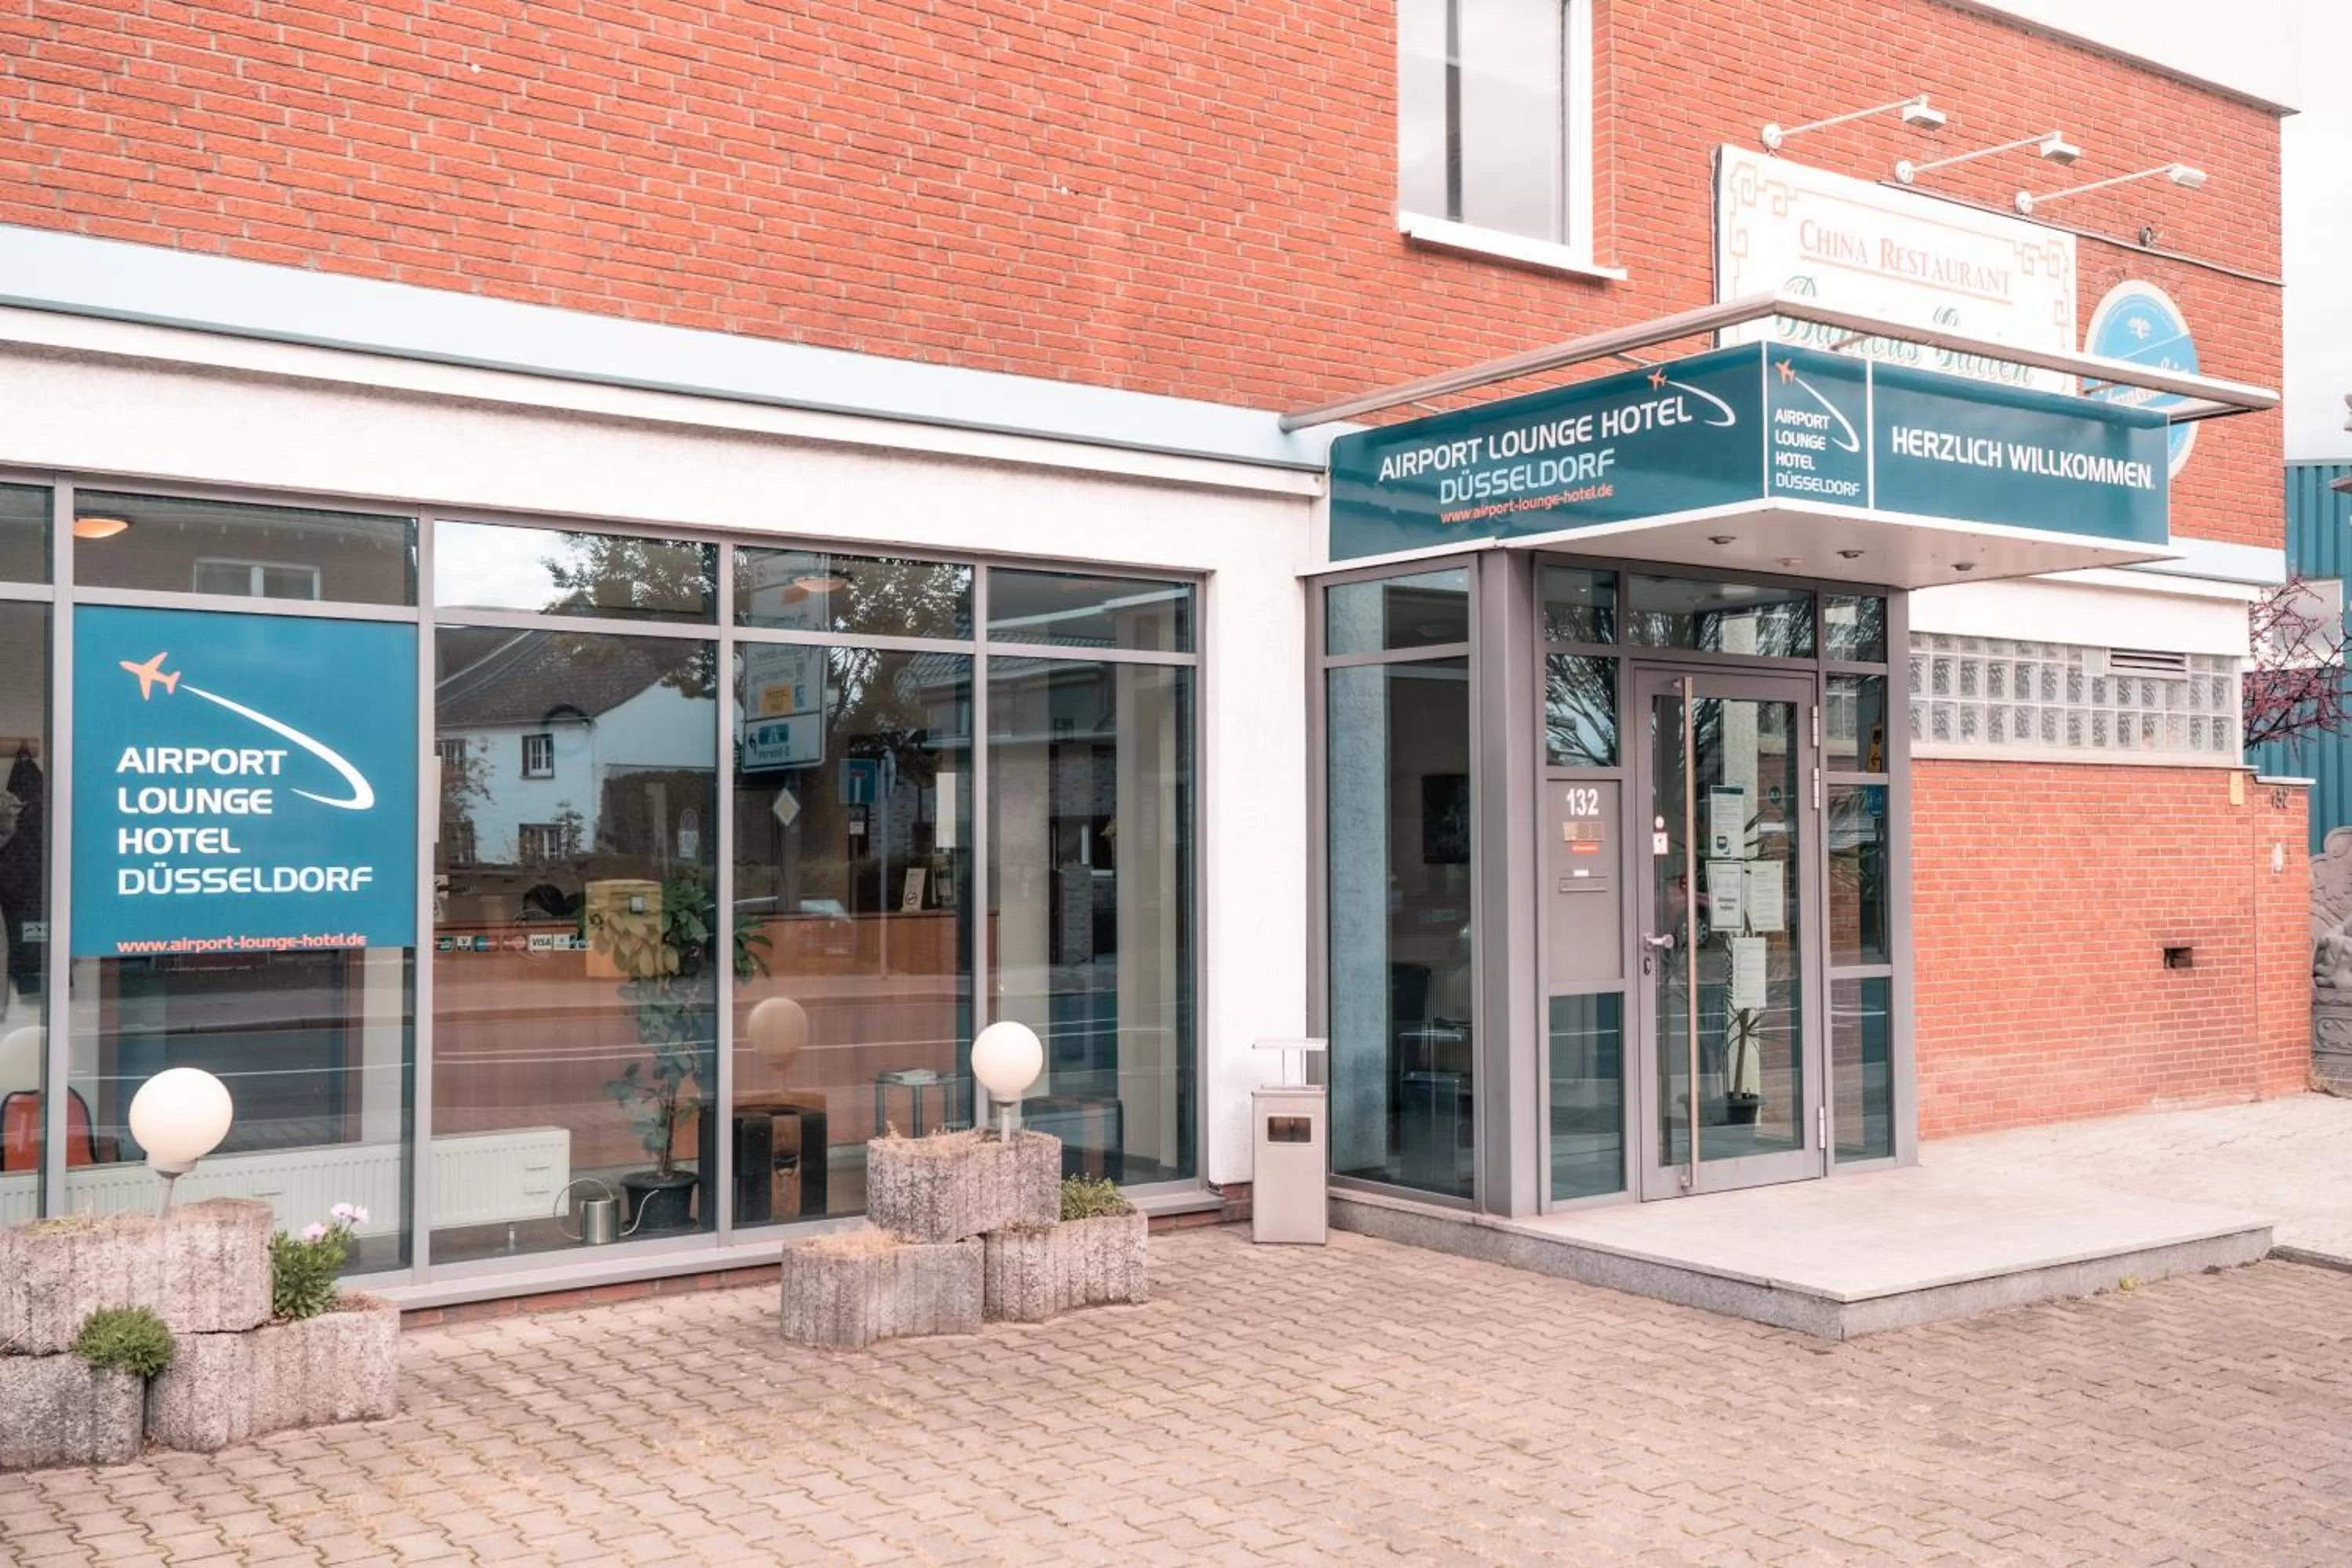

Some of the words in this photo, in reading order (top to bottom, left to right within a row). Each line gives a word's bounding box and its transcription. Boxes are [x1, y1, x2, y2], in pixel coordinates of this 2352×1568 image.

[1799, 220, 1868, 264] CHINA
[1880, 238, 2011, 296] RESTAURANT
[1774, 408, 1831, 430] AIRPORT
[1378, 437, 1483, 482] AIRPORT
[1489, 415, 1593, 459] LOUNGE
[1601, 395, 1693, 439] HOTEL
[1774, 429, 1827, 451] LOUNGE
[1891, 426, 2003, 468] HERZLICH
[1775, 451, 1817, 471] HOTEL
[1439, 448, 1616, 506] DÜSSELDORF
[1775, 470, 1861, 497] DÜSSELDORF
[1440, 482, 1613, 524] www.airport-lounge-hotel.de
[116, 747, 288, 775] AIRPORT
[118, 787, 273, 815] LOUNGE
[1566, 788, 1599, 816] 132
[118, 828, 241, 855] HOTEL
[118, 862, 373, 895] DÜSSELDORF
[117, 933, 367, 953] www.airport-lounge-hotel.de
